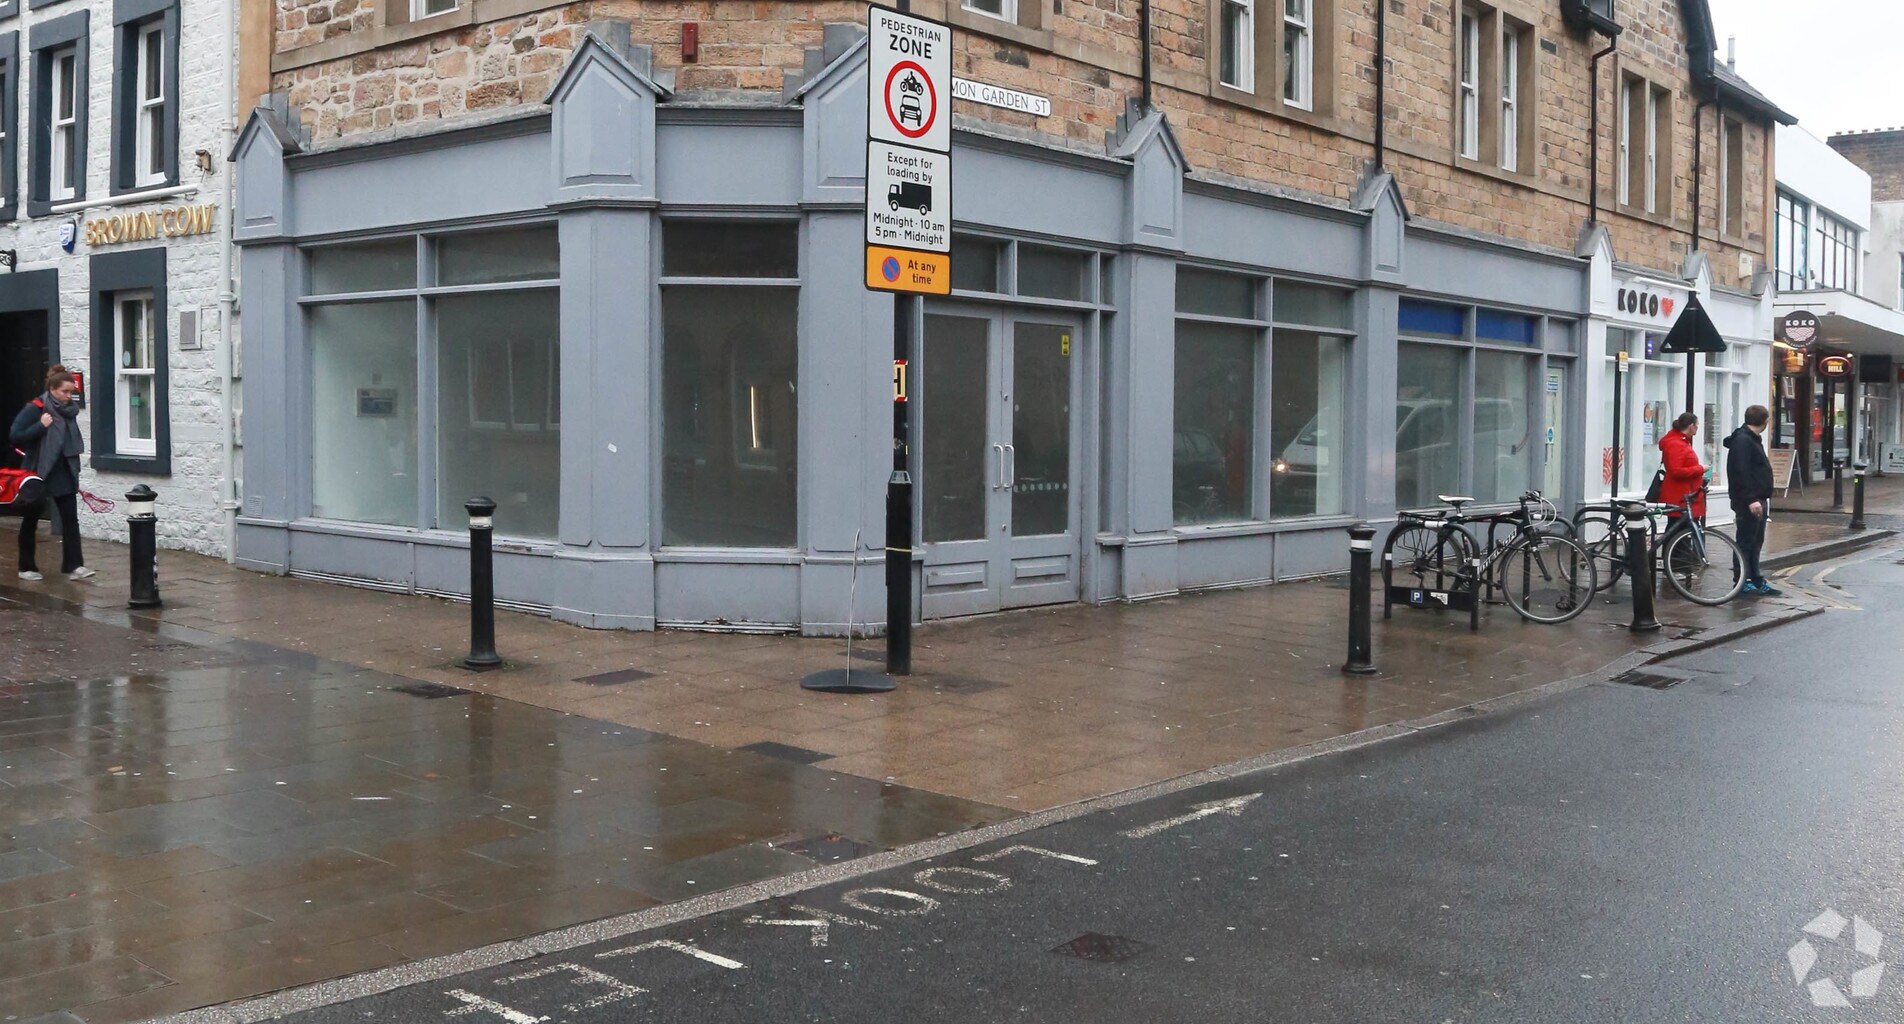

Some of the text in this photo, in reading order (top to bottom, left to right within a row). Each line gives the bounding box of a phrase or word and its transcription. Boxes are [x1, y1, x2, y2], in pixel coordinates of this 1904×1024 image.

[881, 17, 941, 43] PEDESTRIAN
[889, 34, 932, 59] ZONE
[952, 80, 1047, 114] MON GARDEN ST
[887, 152, 933, 169] Except for
[887, 165, 932, 184] loading by
[85, 210, 159, 247] BROWN
[162, 202, 217, 238] COW
[873, 212, 913, 229] Midnight
[920, 219, 931, 230] 10
[932, 222, 945, 232] am
[875, 226, 881, 237] 5
[883, 229, 897, 240] pm
[904, 231, 943, 245] Midnight
[908, 259, 936, 274] At any
[912, 272, 932, 285] time
[1617, 287, 1659, 318] KOKO
[1827, 365, 1844, 373] HILL
[1413, 592, 1420, 601] P
